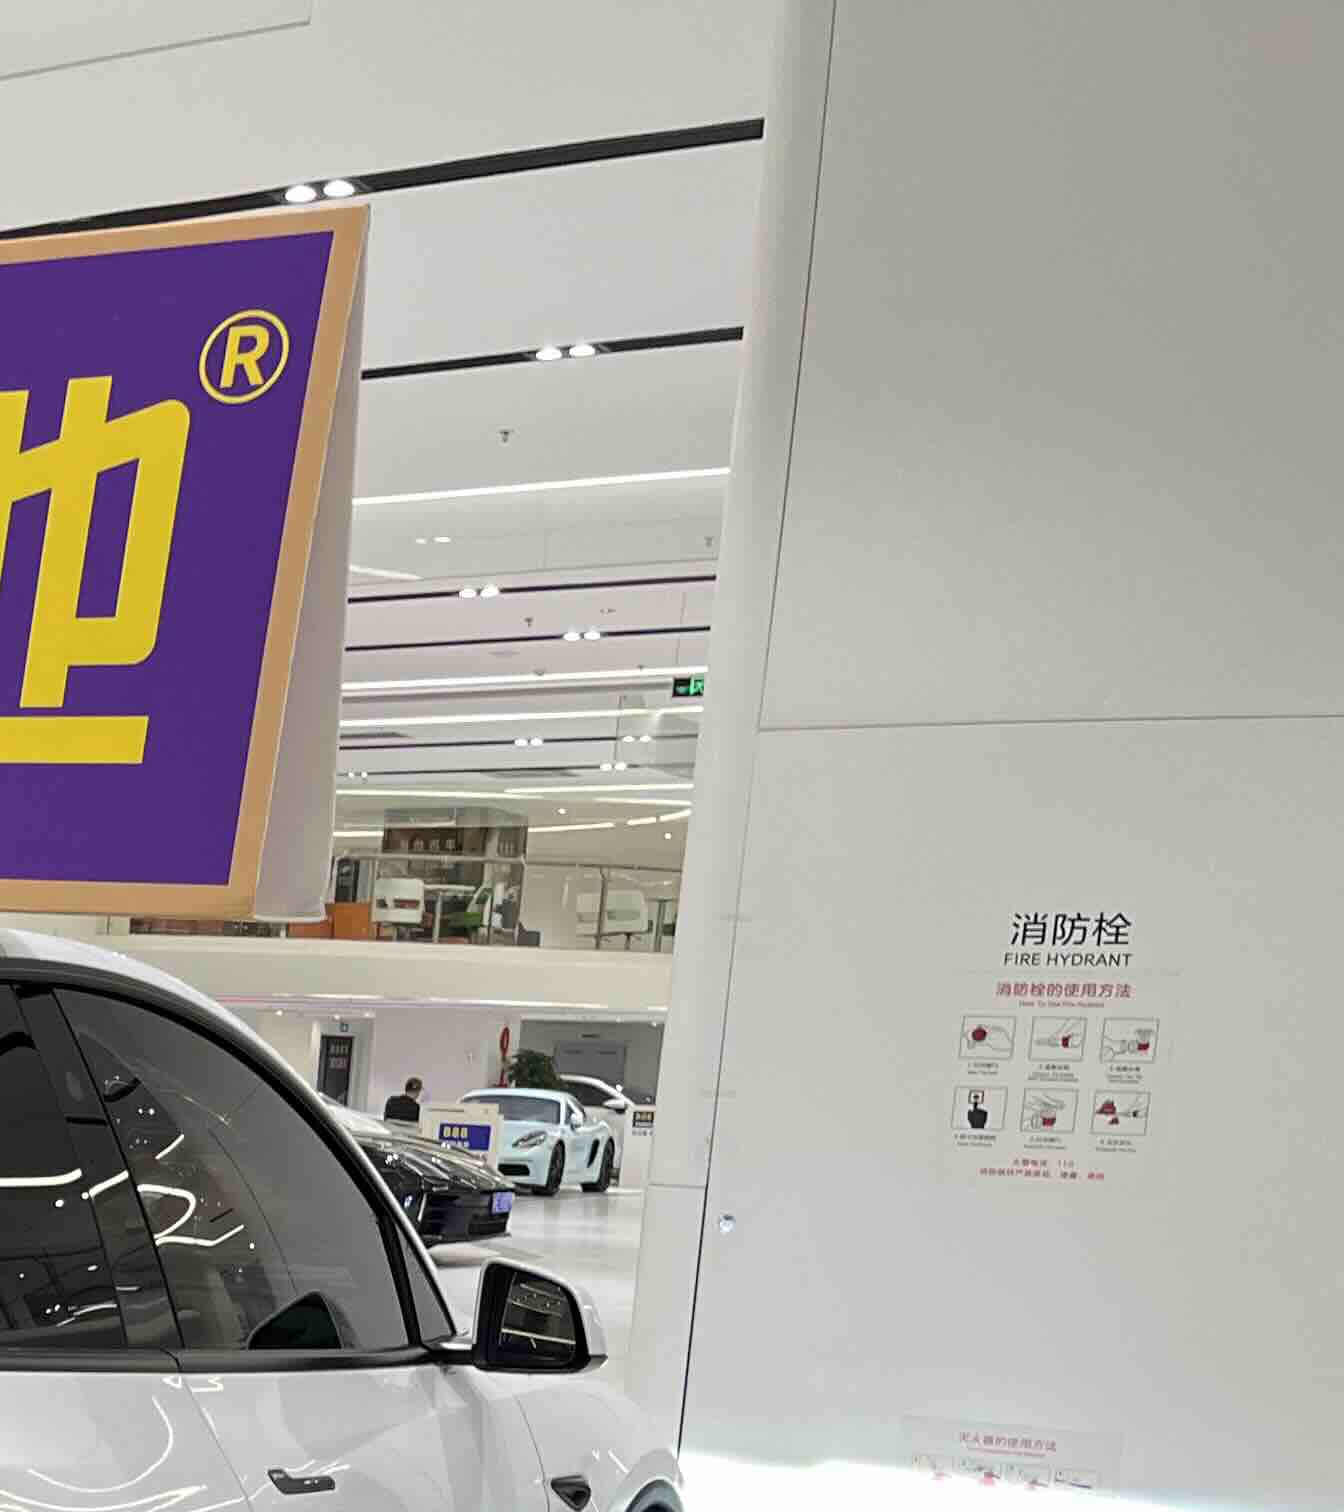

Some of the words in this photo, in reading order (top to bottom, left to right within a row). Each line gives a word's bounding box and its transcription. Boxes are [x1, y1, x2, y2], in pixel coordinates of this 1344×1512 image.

[1010, 911, 1132, 946] 消防栓
[1003, 951, 1041, 967] FIRE
[1047, 951, 1133, 967] HYDRANT
